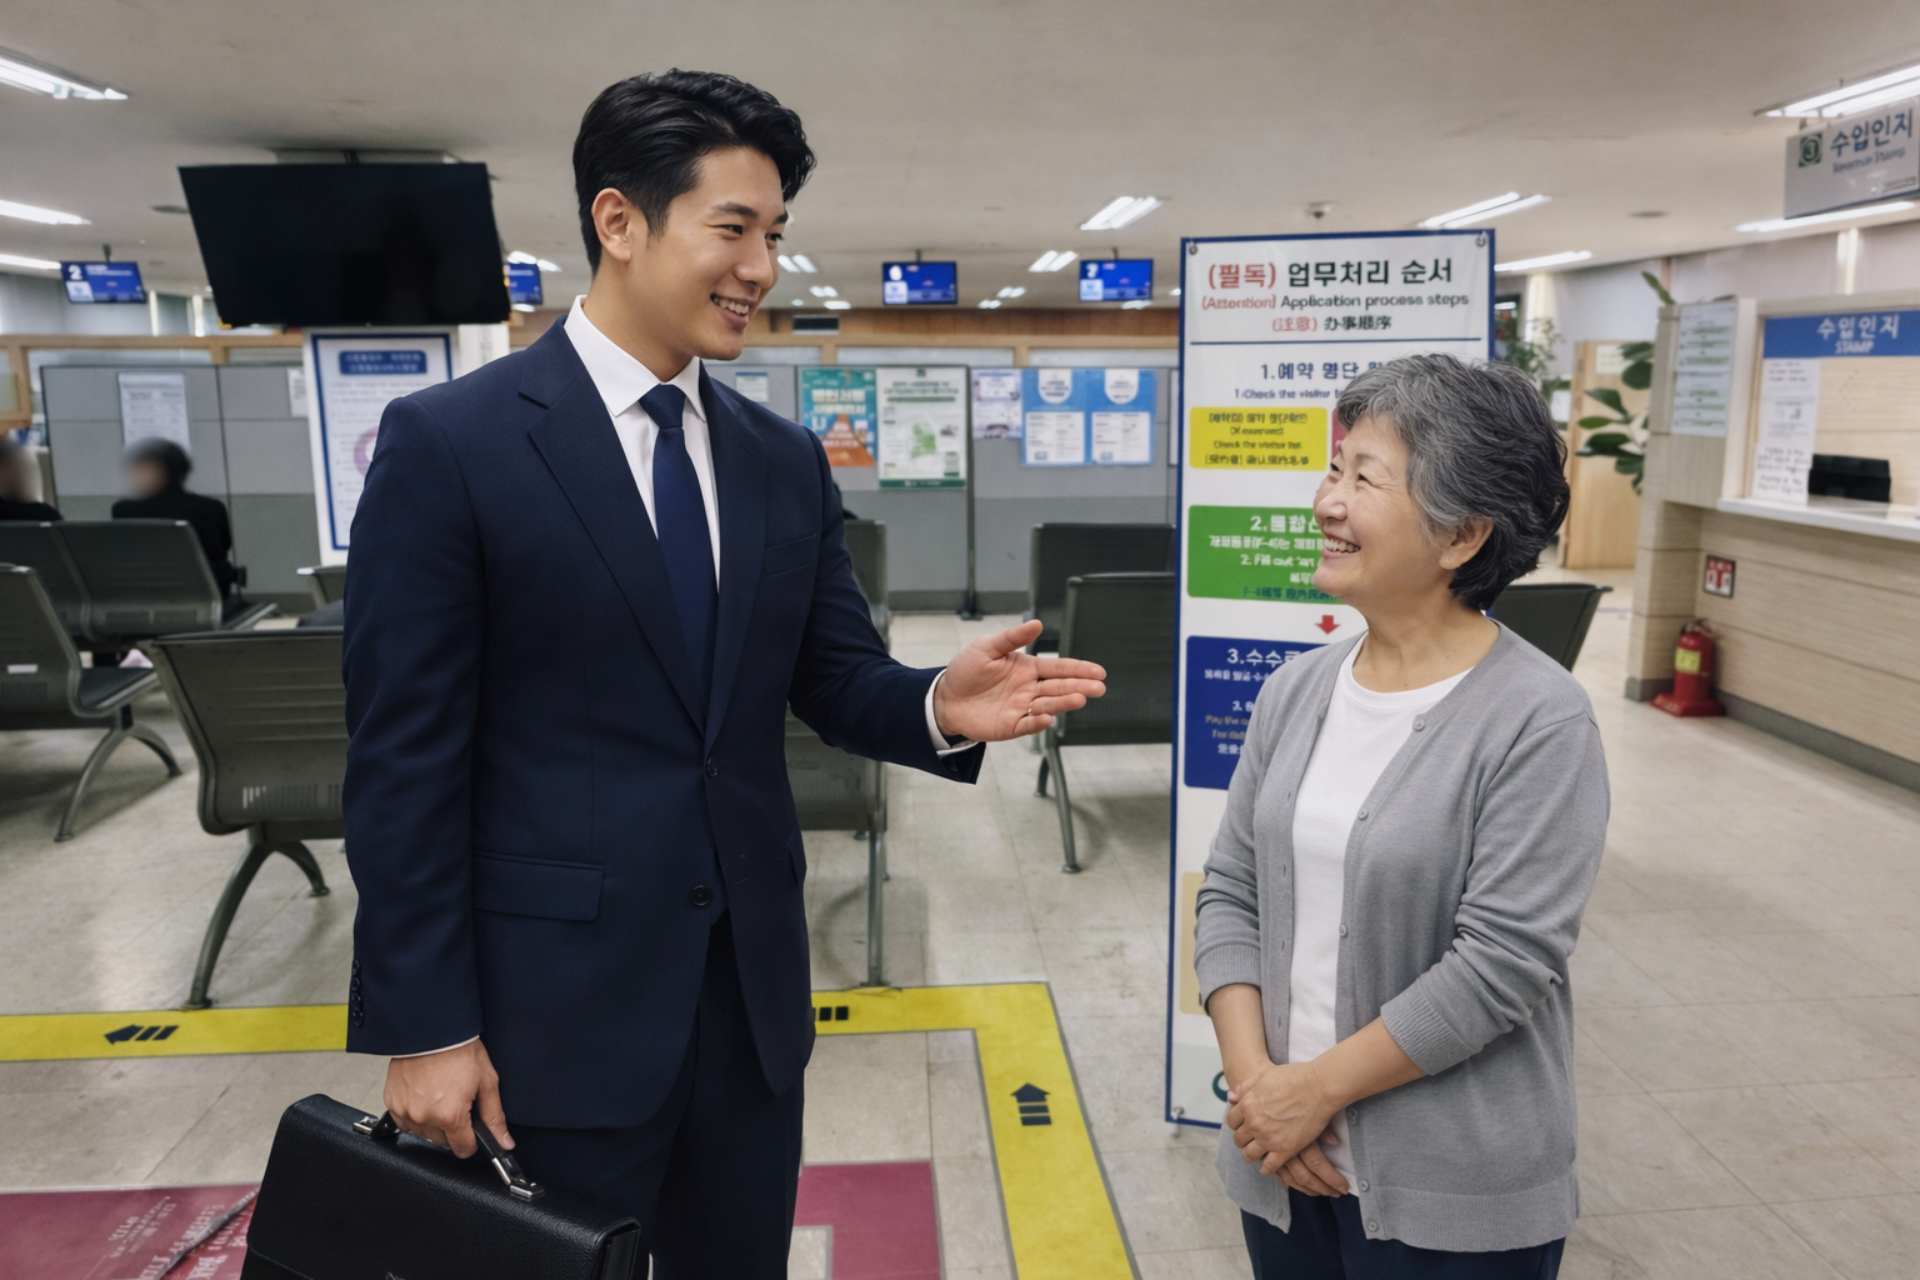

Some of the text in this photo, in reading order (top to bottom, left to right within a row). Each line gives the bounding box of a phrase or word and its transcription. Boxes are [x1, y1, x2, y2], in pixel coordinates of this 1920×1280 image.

[1830, 107, 1913, 157] 수입인지
[68, 264, 83, 280] 2
[1208, 258, 1453, 289] (필독) 업무처리 순서
[1281, 295, 1361, 310] Application
[1365, 295, 1423, 310] process
[1427, 293, 1469, 308] steps
[1817, 314, 1900, 340] 수입인지
[1835, 340, 1875, 355] STAMP
[1261, 363, 1314, 380] 1.예약
